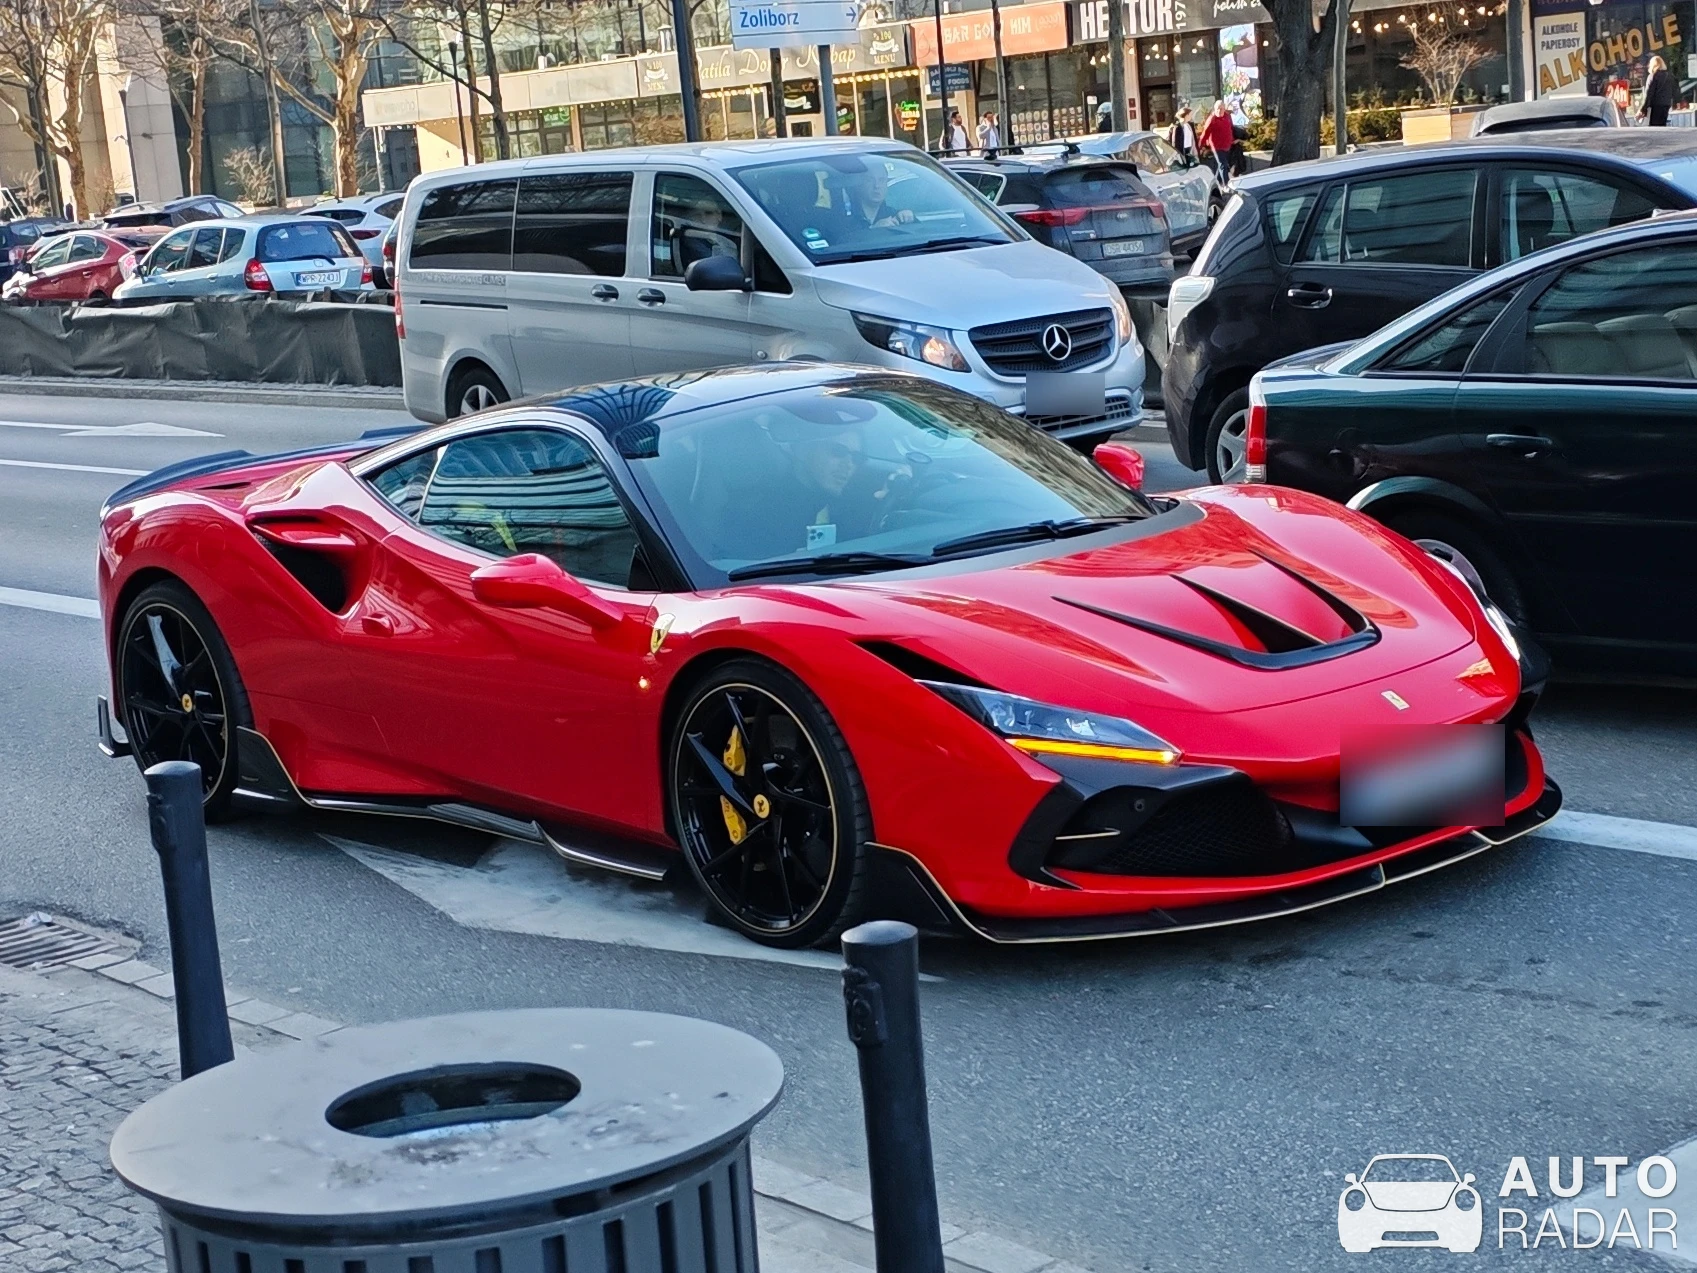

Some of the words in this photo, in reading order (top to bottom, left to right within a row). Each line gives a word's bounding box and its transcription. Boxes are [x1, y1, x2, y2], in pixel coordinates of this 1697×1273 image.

[740, 7, 799, 28] Żoliborz
[1079, 0, 1174, 41] HETOR
[944, 25, 970, 45] BAR
[1541, 22, 1578, 36] ALKOHOLE
[1539, 13, 1682, 96] ALKOHOLE
[1541, 37, 1580, 51] PAPIEROSY
[796, 44, 856, 70] Kbap
[1606, 83, 1629, 107] 24h
